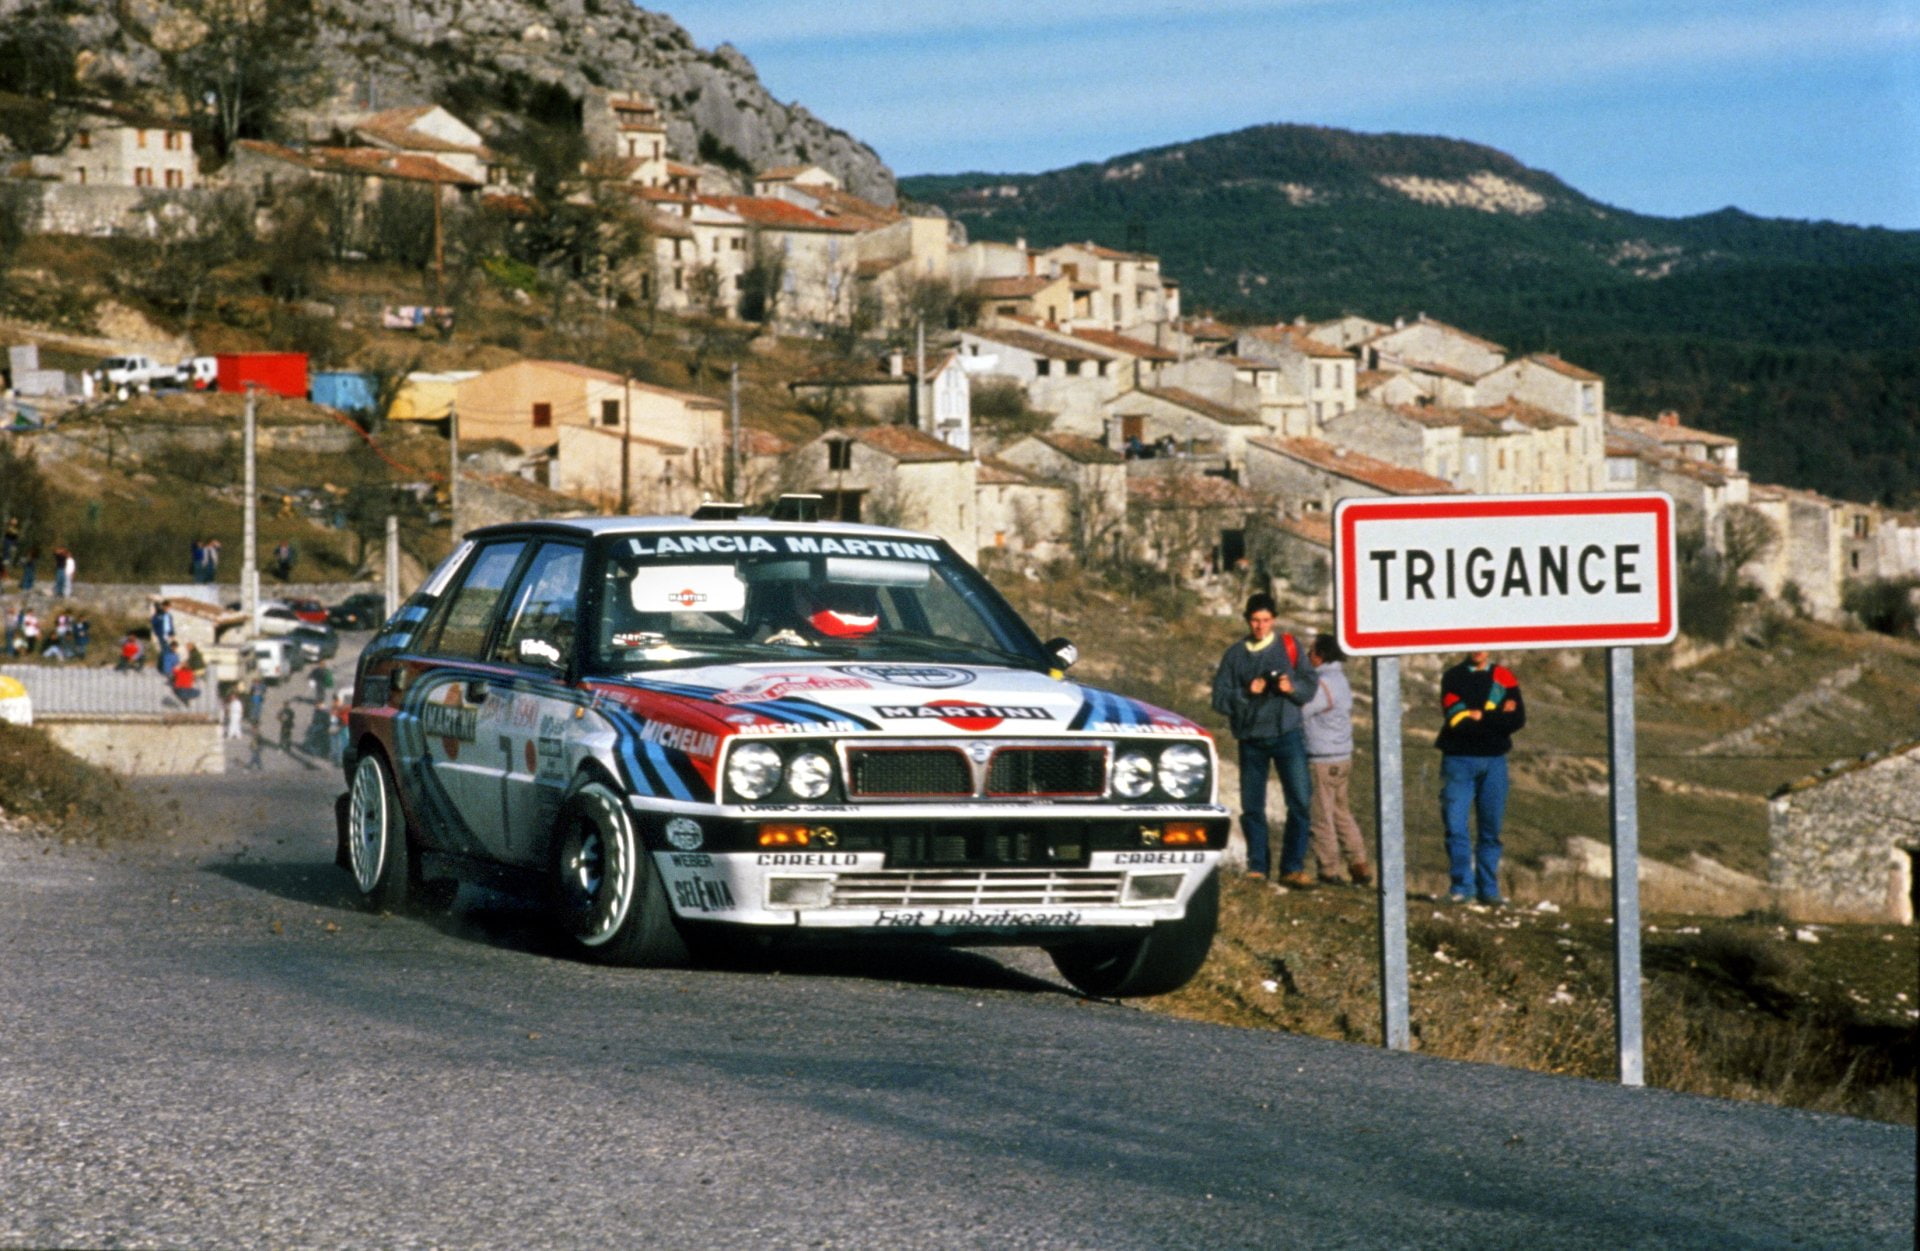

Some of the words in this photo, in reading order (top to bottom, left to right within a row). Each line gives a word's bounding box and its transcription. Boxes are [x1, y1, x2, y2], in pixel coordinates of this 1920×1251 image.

[629, 535, 776, 556] LANCIA
[785, 536, 941, 562] MARTINI
[1369, 544, 1642, 601] TRIGANCE
[669, 593, 706, 601] MARTINI
[882, 706, 1045, 719] MARTINI
[640, 719, 719, 758] MICHELIN
[670, 853, 714, 868] WEBER
[757, 854, 858, 866] CARELLO
[1114, 852, 1206, 864] CARELLO
